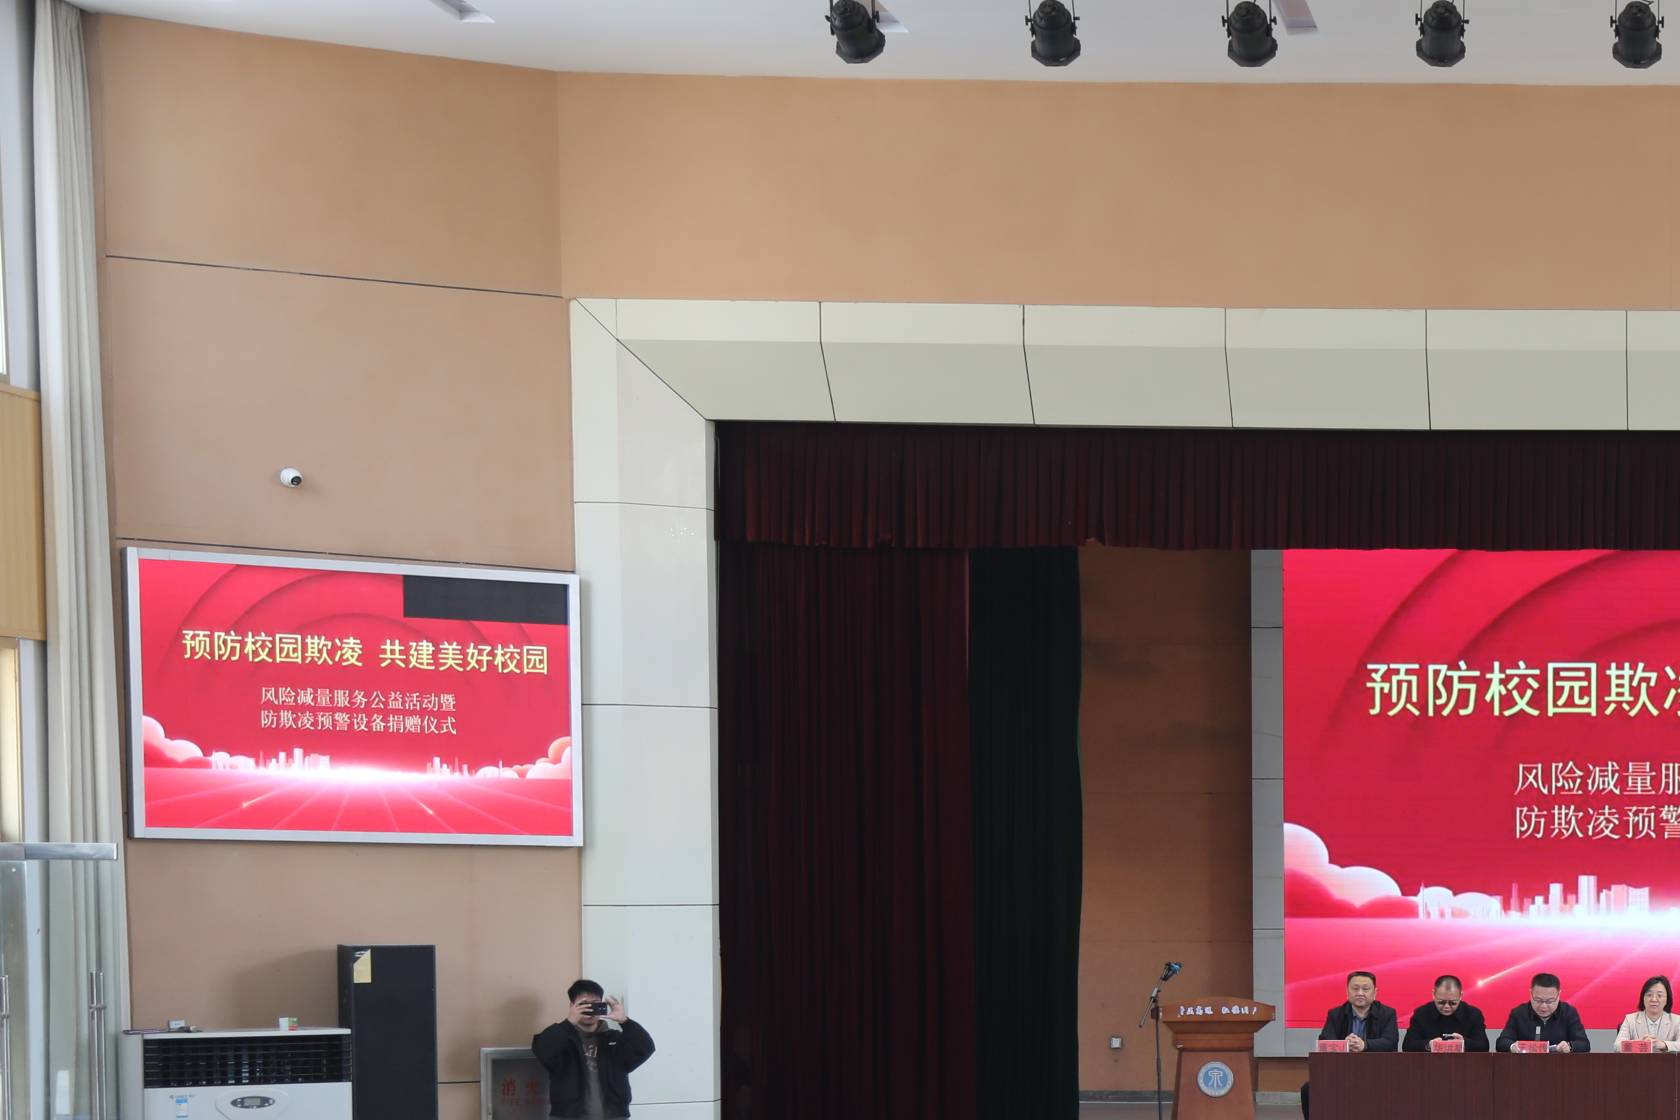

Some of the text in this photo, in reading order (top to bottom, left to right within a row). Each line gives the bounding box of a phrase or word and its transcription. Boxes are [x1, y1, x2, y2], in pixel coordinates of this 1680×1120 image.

[182, 629, 549, 676] 预防校园欺凌 共建美好校园
[260, 686, 457, 713] 风险减量服务公益活动暨
[260, 708, 457, 736] 防欺凌预警设备捐赠仪式
